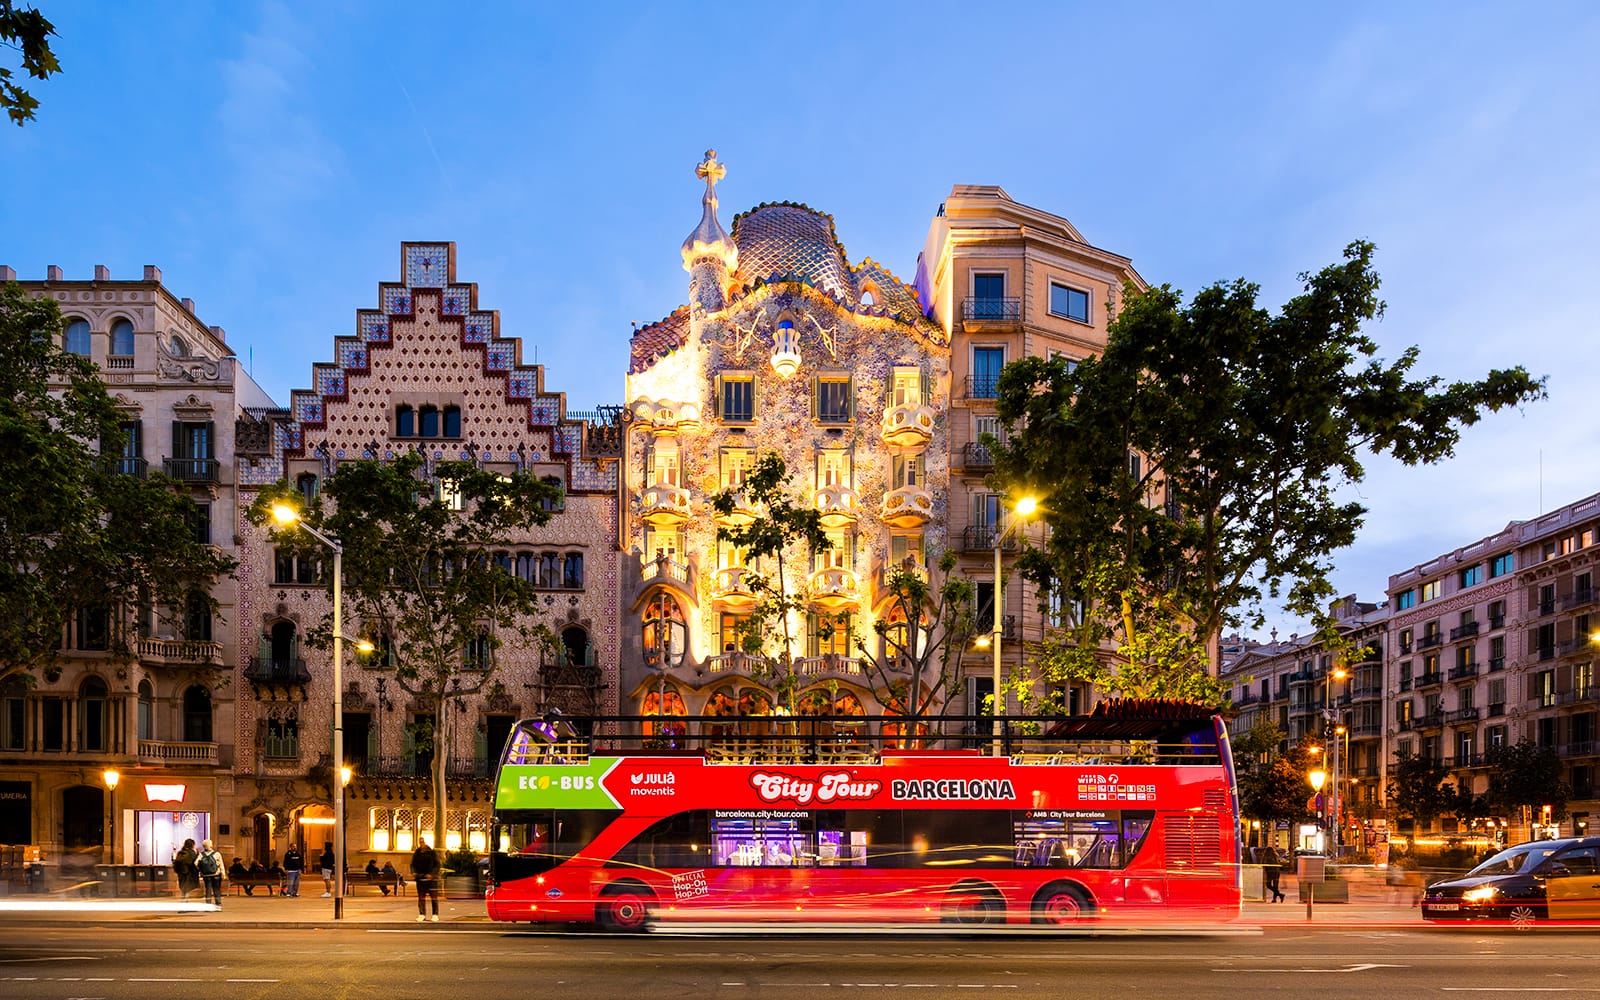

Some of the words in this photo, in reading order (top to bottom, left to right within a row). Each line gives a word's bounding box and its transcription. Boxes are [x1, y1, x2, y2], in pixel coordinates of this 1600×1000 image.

[630, 786, 676, 796] moventis
[752, 773, 814, 803] City
[817, 773, 879, 801] Tour
[891, 779, 1016, 801] BARCELONA
[0, 792, 27, 800] UMERIA
[715, 810, 809, 820] barcelona.city-tour.com
[1050, 811, 1062, 819] City
[671, 871, 706, 884] OFFICIAL
[673, 879, 707, 891] Hop-On
[675, 885, 709, 900] Hop-Off
